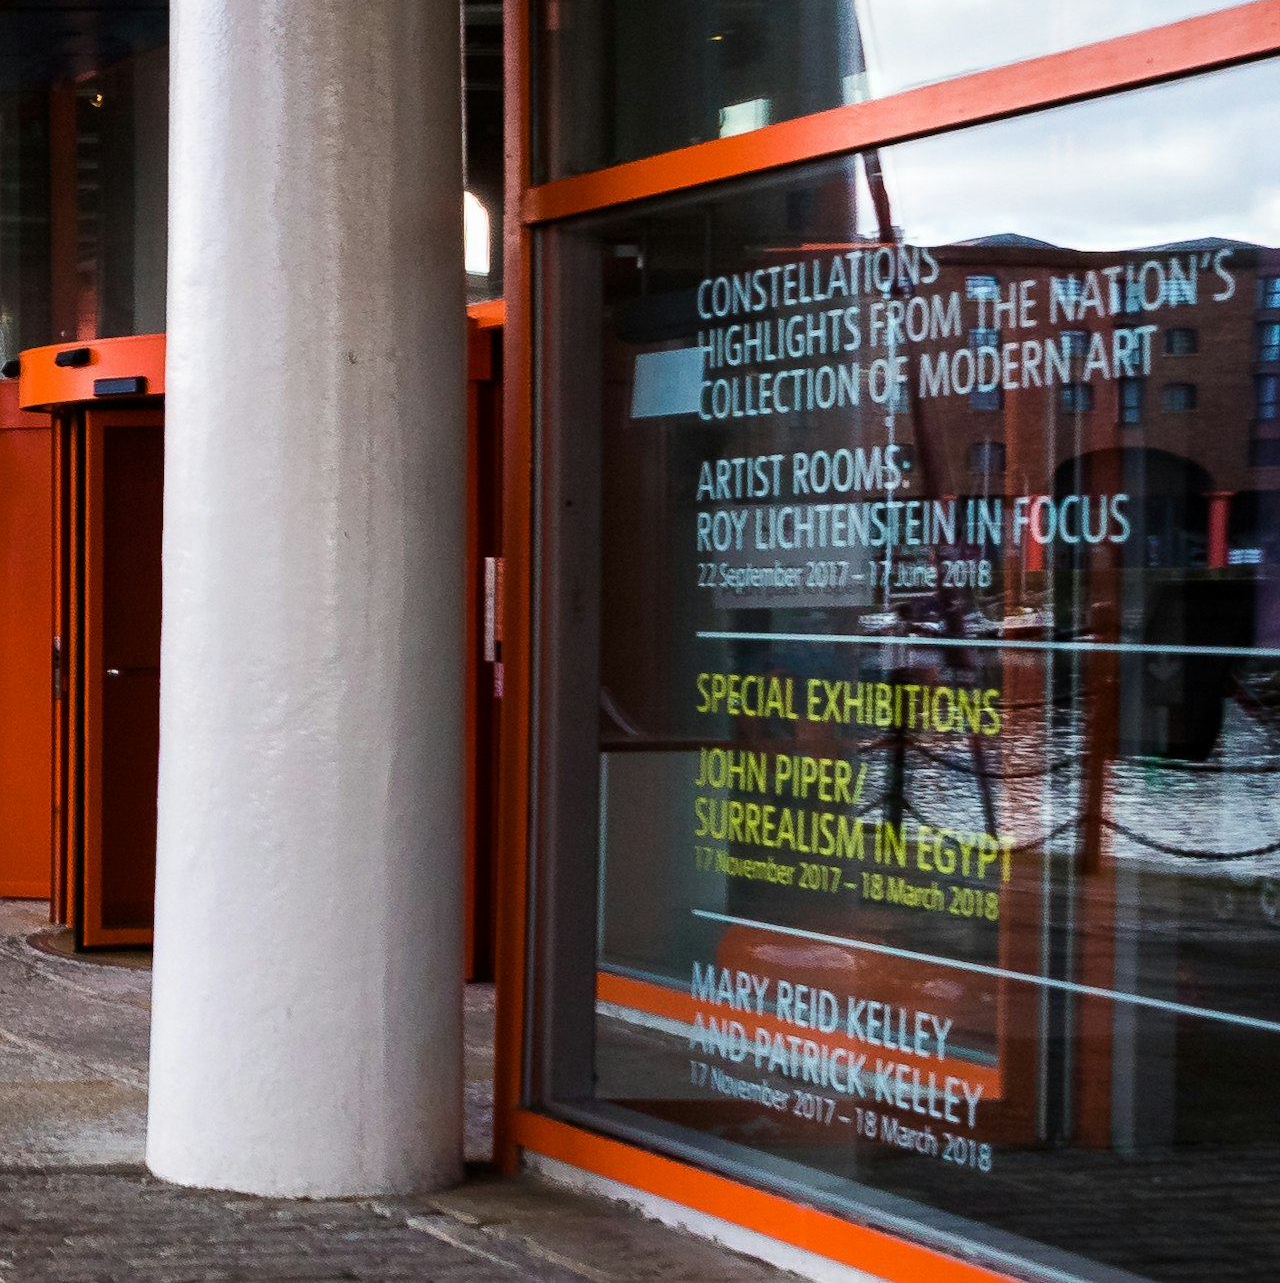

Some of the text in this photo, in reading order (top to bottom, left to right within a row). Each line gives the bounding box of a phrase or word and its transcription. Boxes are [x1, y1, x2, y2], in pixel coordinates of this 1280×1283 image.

[697, 247, 940, 318] CONSTELLATIONS
[698, 306, 862, 368] HIGHLIGHTS
[869, 291, 963, 348] FROM
[968, 278, 1038, 331] THE
[697, 324, 1160, 421] COLLECTION OF MODERN ART
[696, 444, 912, 501] ARTIST ROOMS:
[696, 493, 1132, 552] ROY LICHTENSTEIN IN FOCUS
[697, 562, 718, 587] 22
[718, 560, 803, 594] September
[805, 560, 850, 588] 2017
[868, 560, 893, 588] 17
[893, 562, 938, 588] June
[941, 558, 991, 588] 2018
[695, 672, 1002, 736] SPECIAL EXHIBITIONS
[695, 747, 767, 795] JOHN
[694, 797, 1017, 883] SURREALISM IN EGYPT
[714, 848, 795, 886] November
[798, 861, 842, 893] 2017
[862, 871, 884, 902] 18
[886, 874, 946, 911] March
[947, 885, 1001, 921] 2018
[691, 961, 953, 1061] MARY REID KELLEY
[690, 1012, 984, 1129] AND PATRICK KELLEY
[710, 1065, 790, 1111] November
[793, 1089, 837, 1126] 2017
[855, 1107, 878, 1138] 18
[880, 1114, 940, 1157] March
[942, 1131, 992, 1173] 2018
